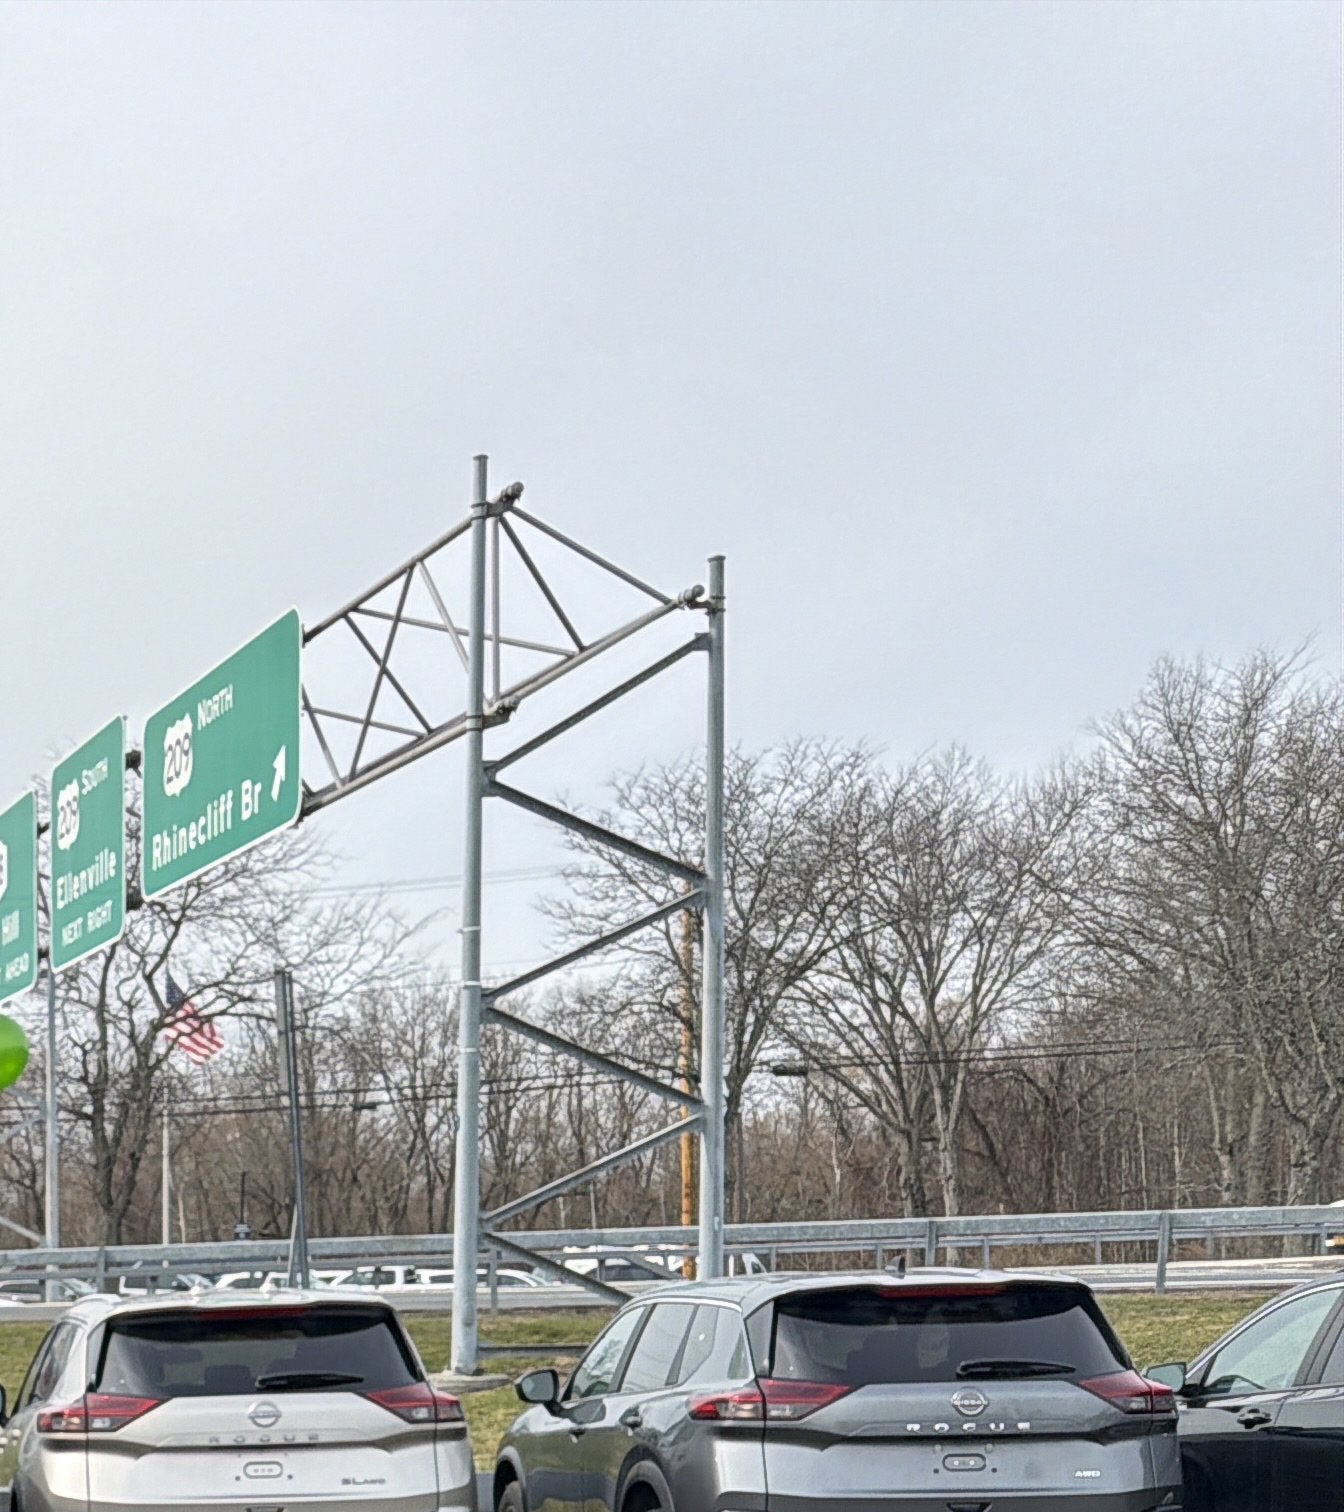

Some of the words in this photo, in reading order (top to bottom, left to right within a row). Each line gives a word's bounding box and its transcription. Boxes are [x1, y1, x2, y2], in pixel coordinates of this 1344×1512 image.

[197, 684, 233, 731] NORTH
[165, 732, 192, 785] 209
[58, 795, 79, 839] 209
[151, 789, 233, 871] Rhinecliff
[241, 778, 262, 821] Br
[55, 847, 117, 910] Ellenville
[61, 917, 83, 947] NEXT
[209, 1432, 320, 1444] ROGUE
[906, 1421, 1031, 1432] ROGUE
